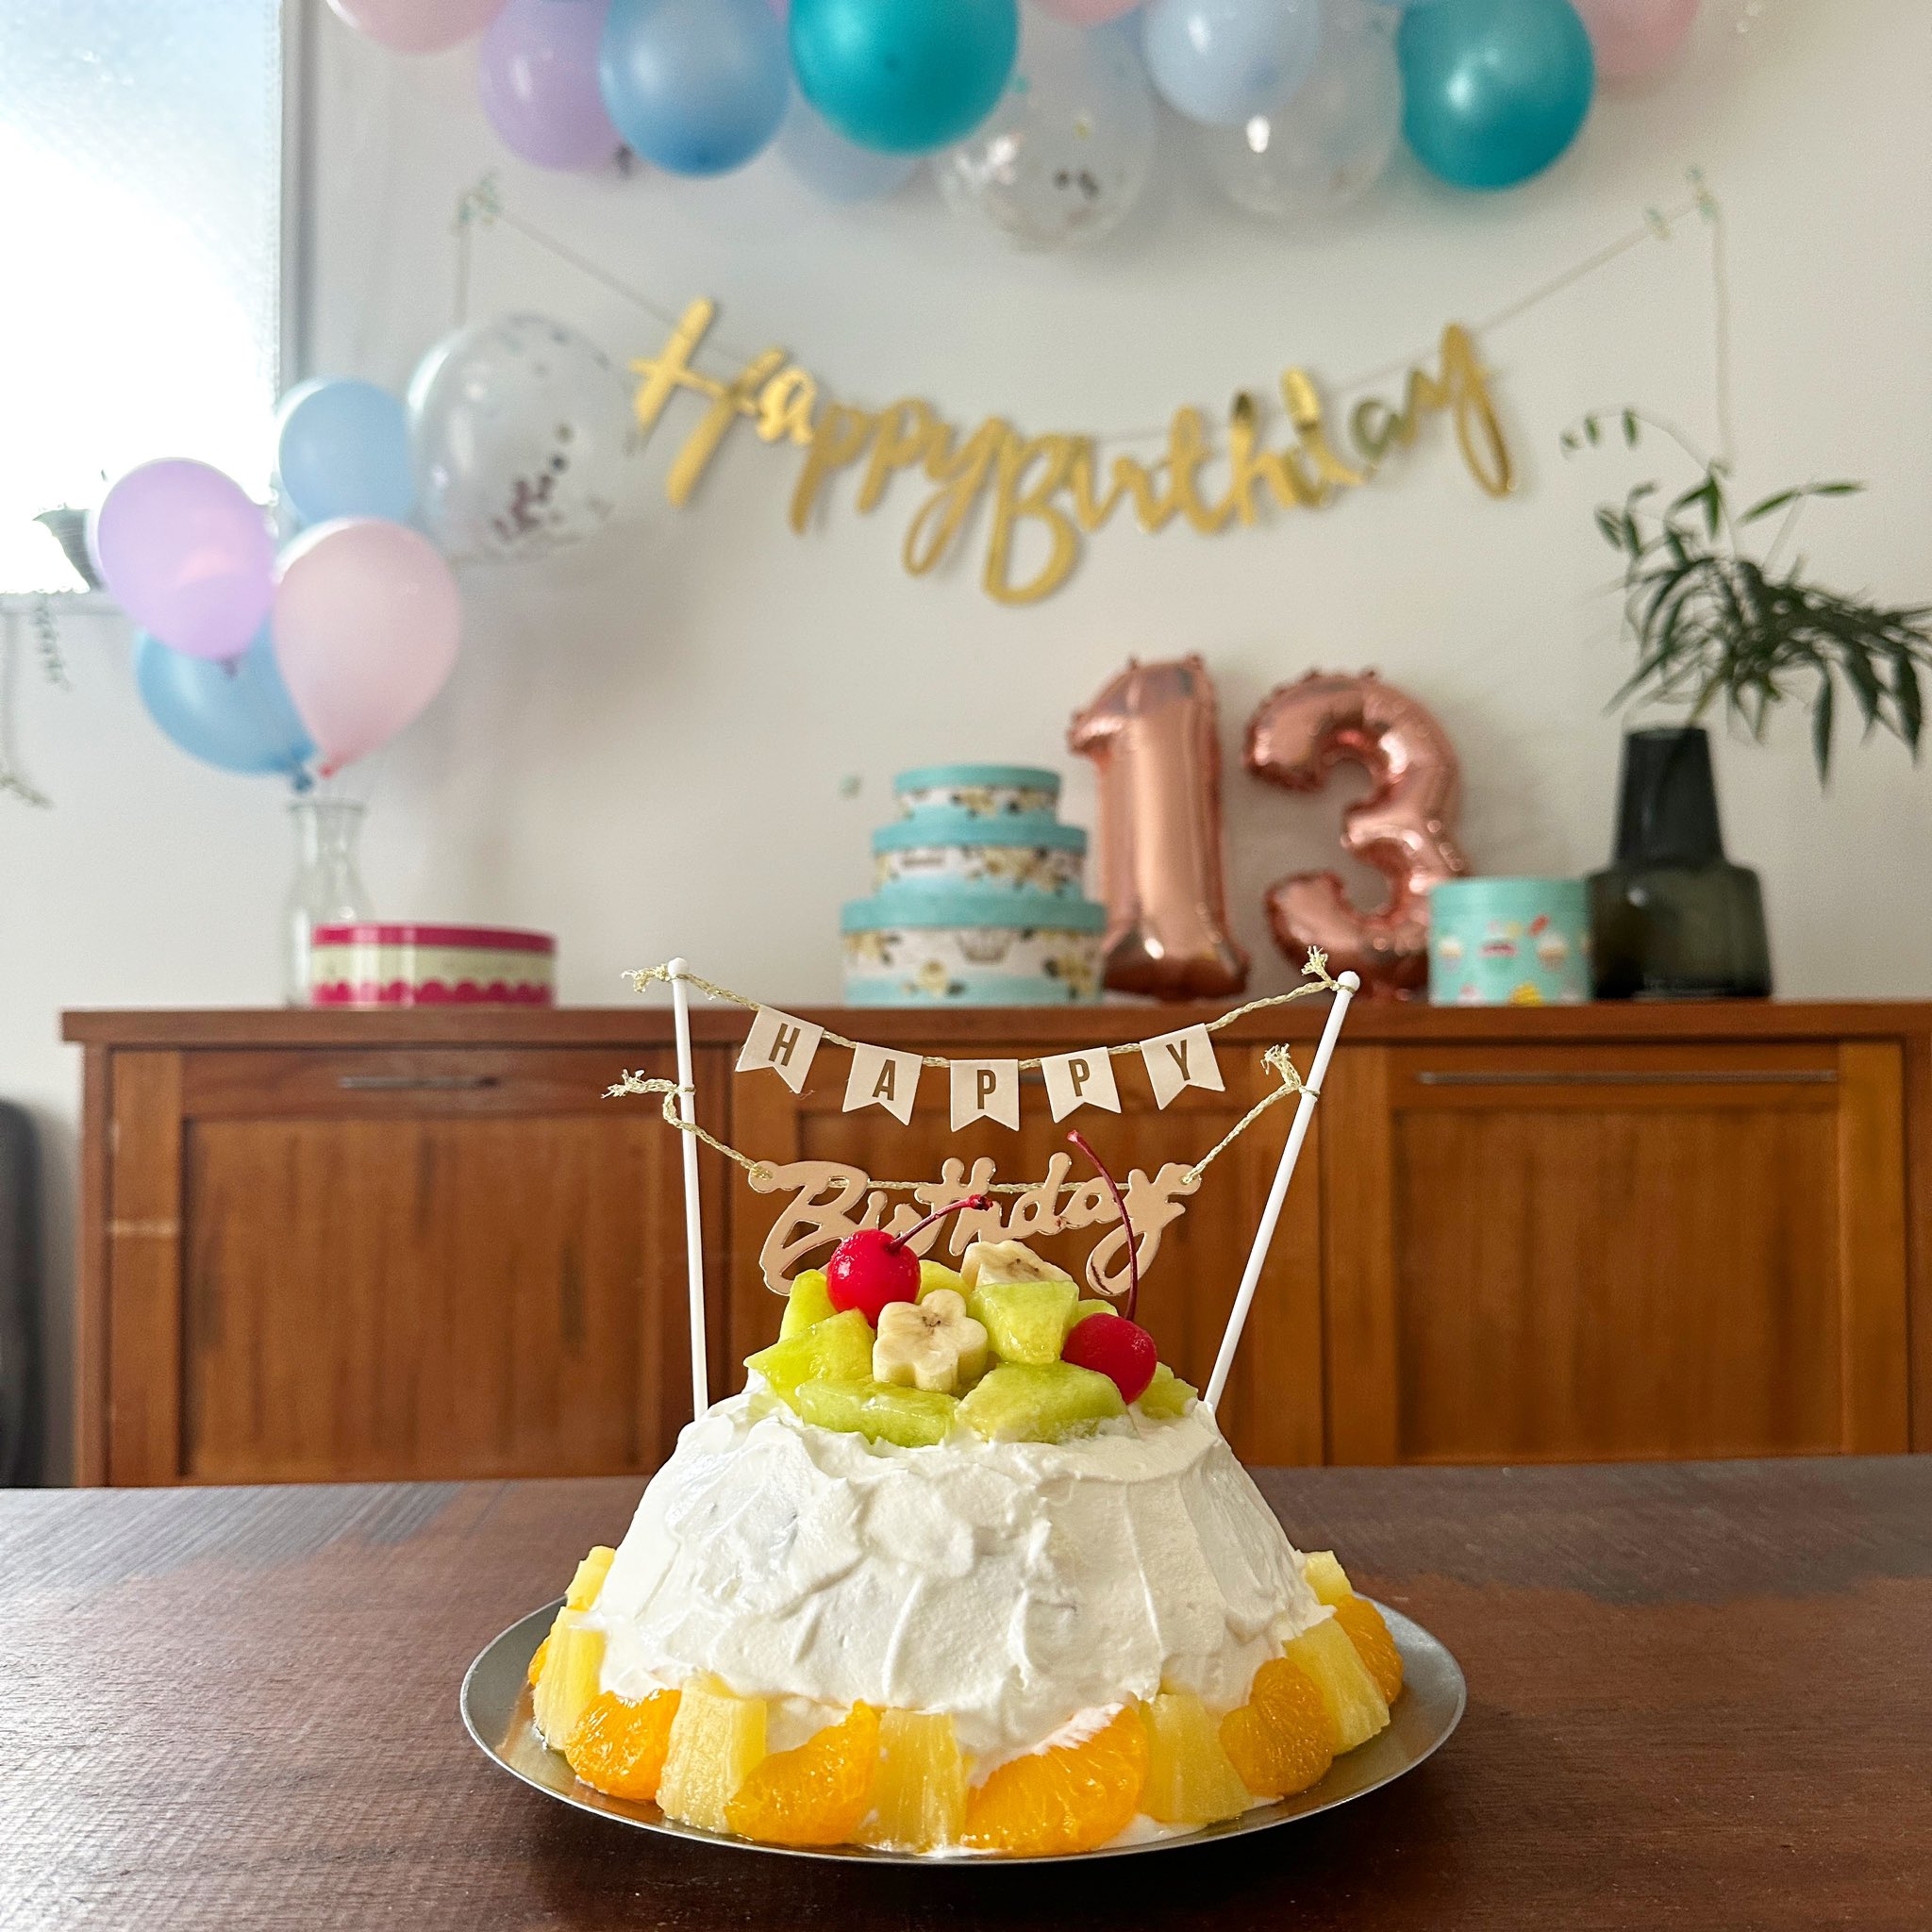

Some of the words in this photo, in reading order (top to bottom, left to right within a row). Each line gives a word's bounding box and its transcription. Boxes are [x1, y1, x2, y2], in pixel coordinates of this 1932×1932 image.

[630, 294, 1006, 577] Happy
[980, 322, 1513, 607] Birthday
[1067, 653, 1470, 1002] 13
[768, 1022, 1194, 1111] HAPPY
